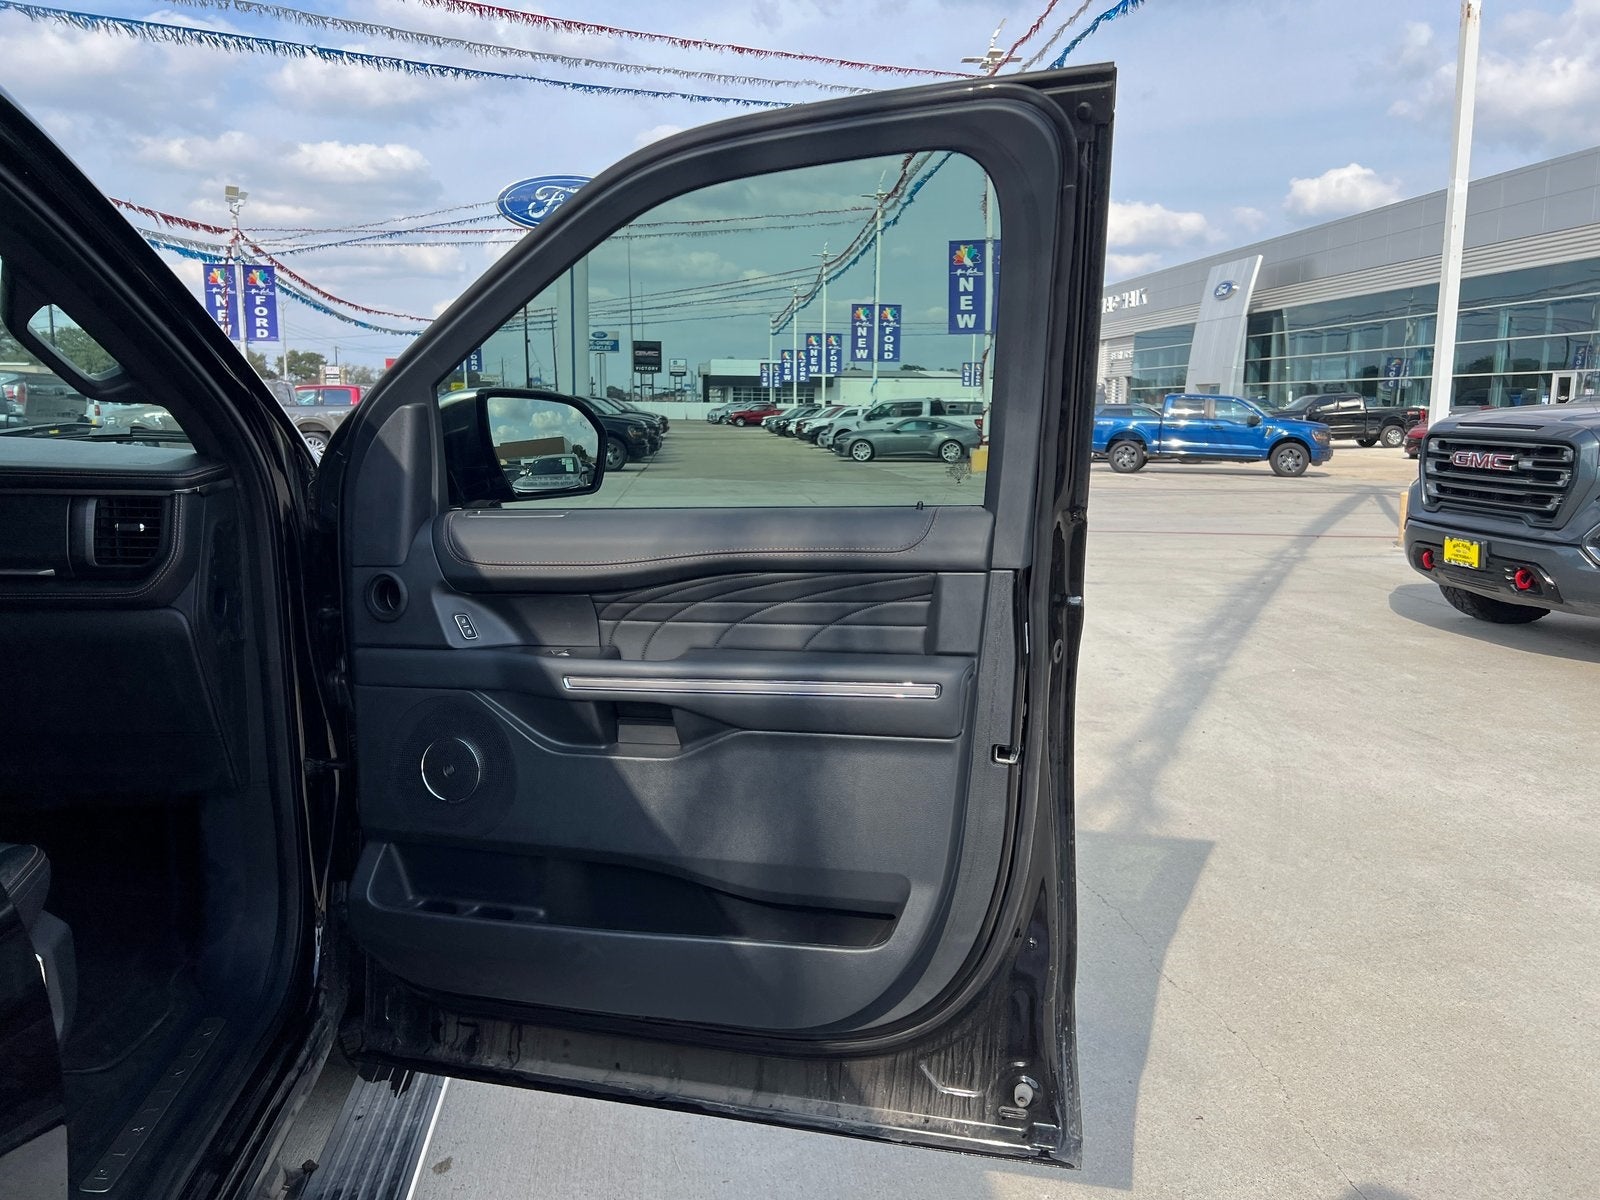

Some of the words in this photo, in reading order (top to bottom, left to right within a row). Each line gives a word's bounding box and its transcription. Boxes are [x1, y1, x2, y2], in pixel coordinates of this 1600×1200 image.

[956, 277, 976, 329] NEW
[254, 295, 269, 338] FORD
[855, 327, 869, 359] NEW
[883, 327, 895, 360] FORD
[470, 354, 478, 371] ORD
[783, 362, 791, 381] NEW
[809, 350, 819, 373] NEW
[830, 350, 838, 373] FORD
[1452, 451, 1514, 471] GMC
